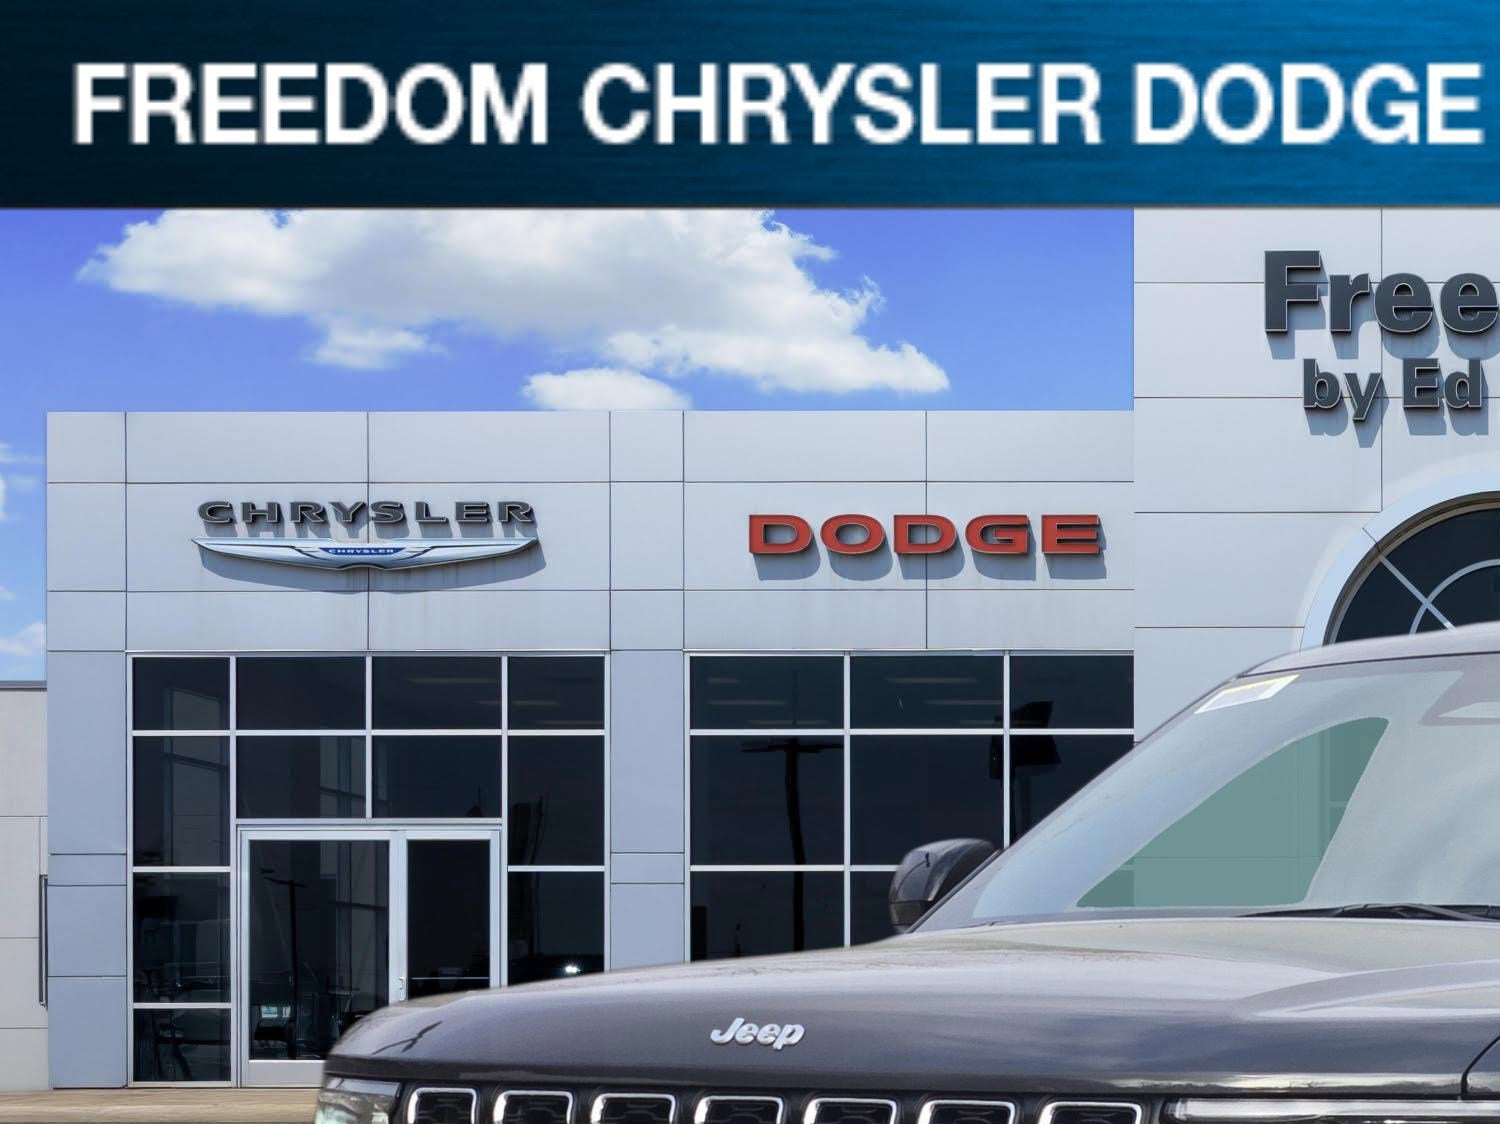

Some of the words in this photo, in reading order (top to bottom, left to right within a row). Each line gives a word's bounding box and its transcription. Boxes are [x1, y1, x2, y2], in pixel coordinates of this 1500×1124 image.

[1303, 358, 1383, 421] by
[1402, 358, 1483, 409] Ed
[197, 500, 534, 525] CHRYSLER
[749, 514, 1101, 554] DODGE
[710, 1017, 805, 1050] Jeep
